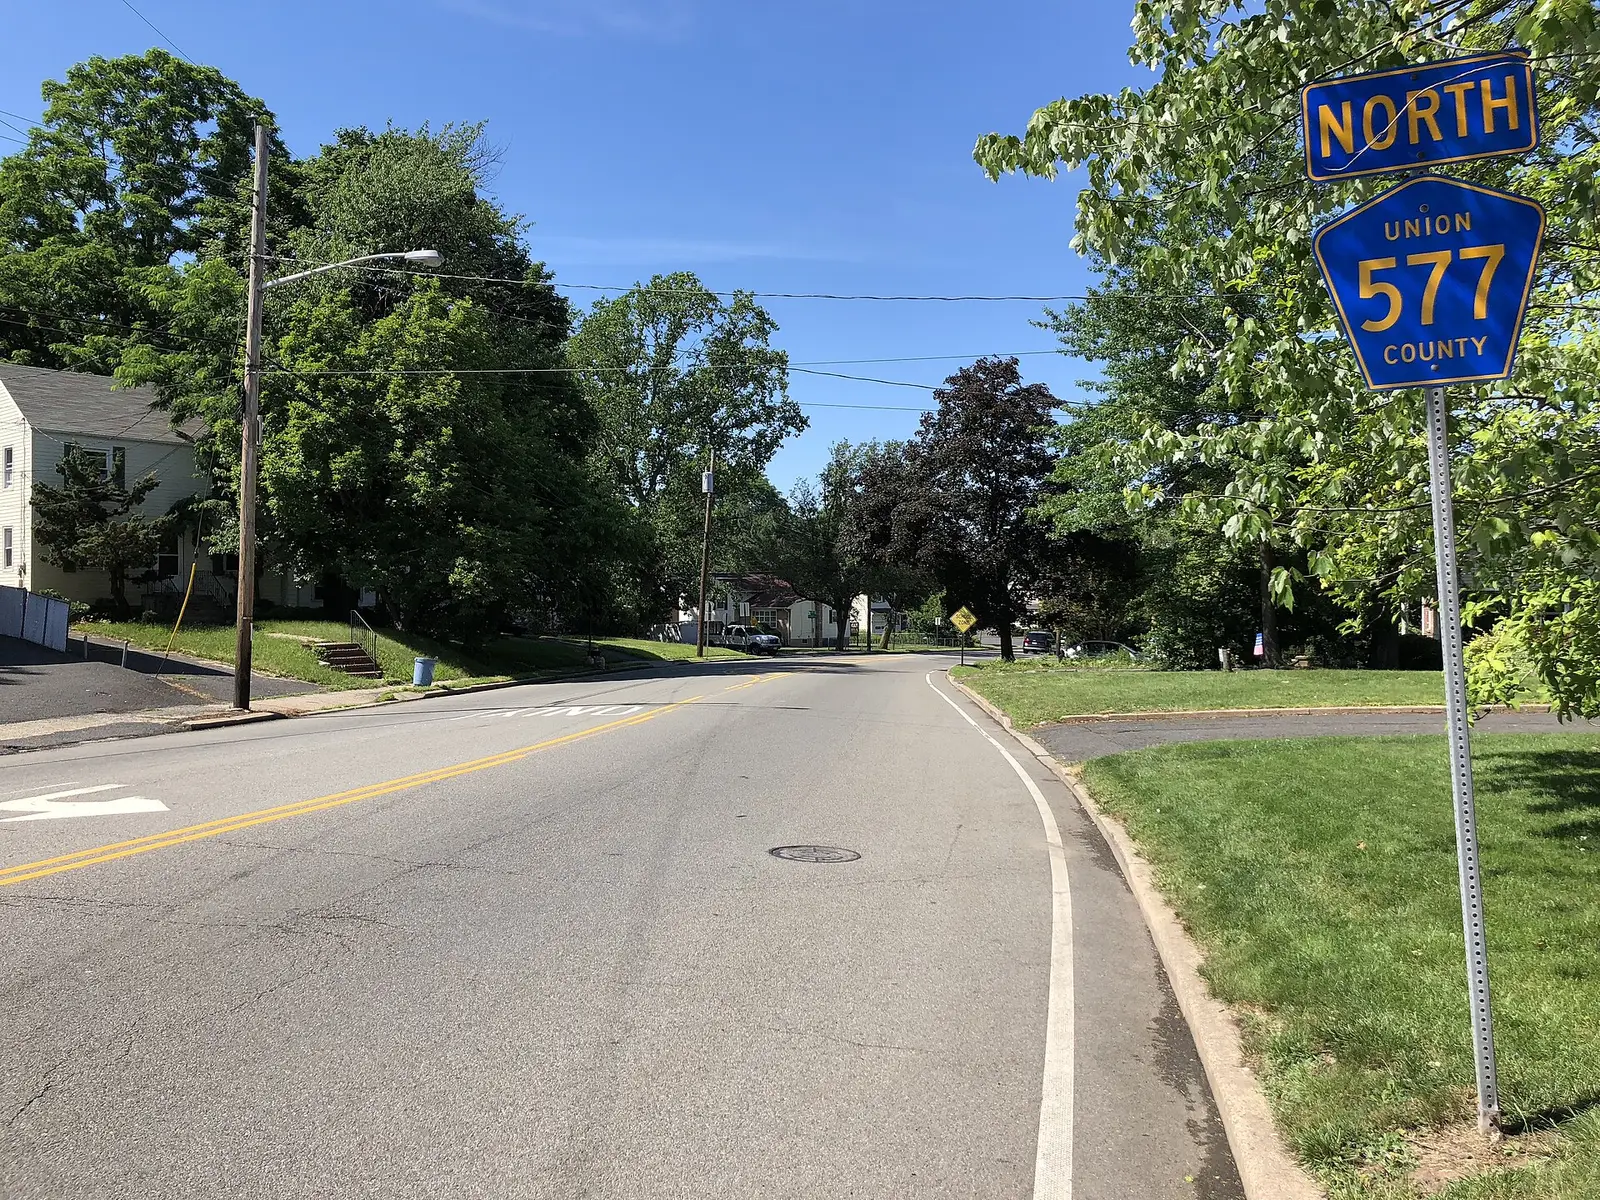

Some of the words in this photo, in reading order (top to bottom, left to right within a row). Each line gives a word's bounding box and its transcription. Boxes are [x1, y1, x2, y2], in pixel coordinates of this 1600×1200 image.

[1318, 75, 1519, 158] NORTH
[1385, 212, 1471, 241] UNION
[1358, 244, 1504, 332] 577
[1384, 336, 1487, 364] COUNTY
